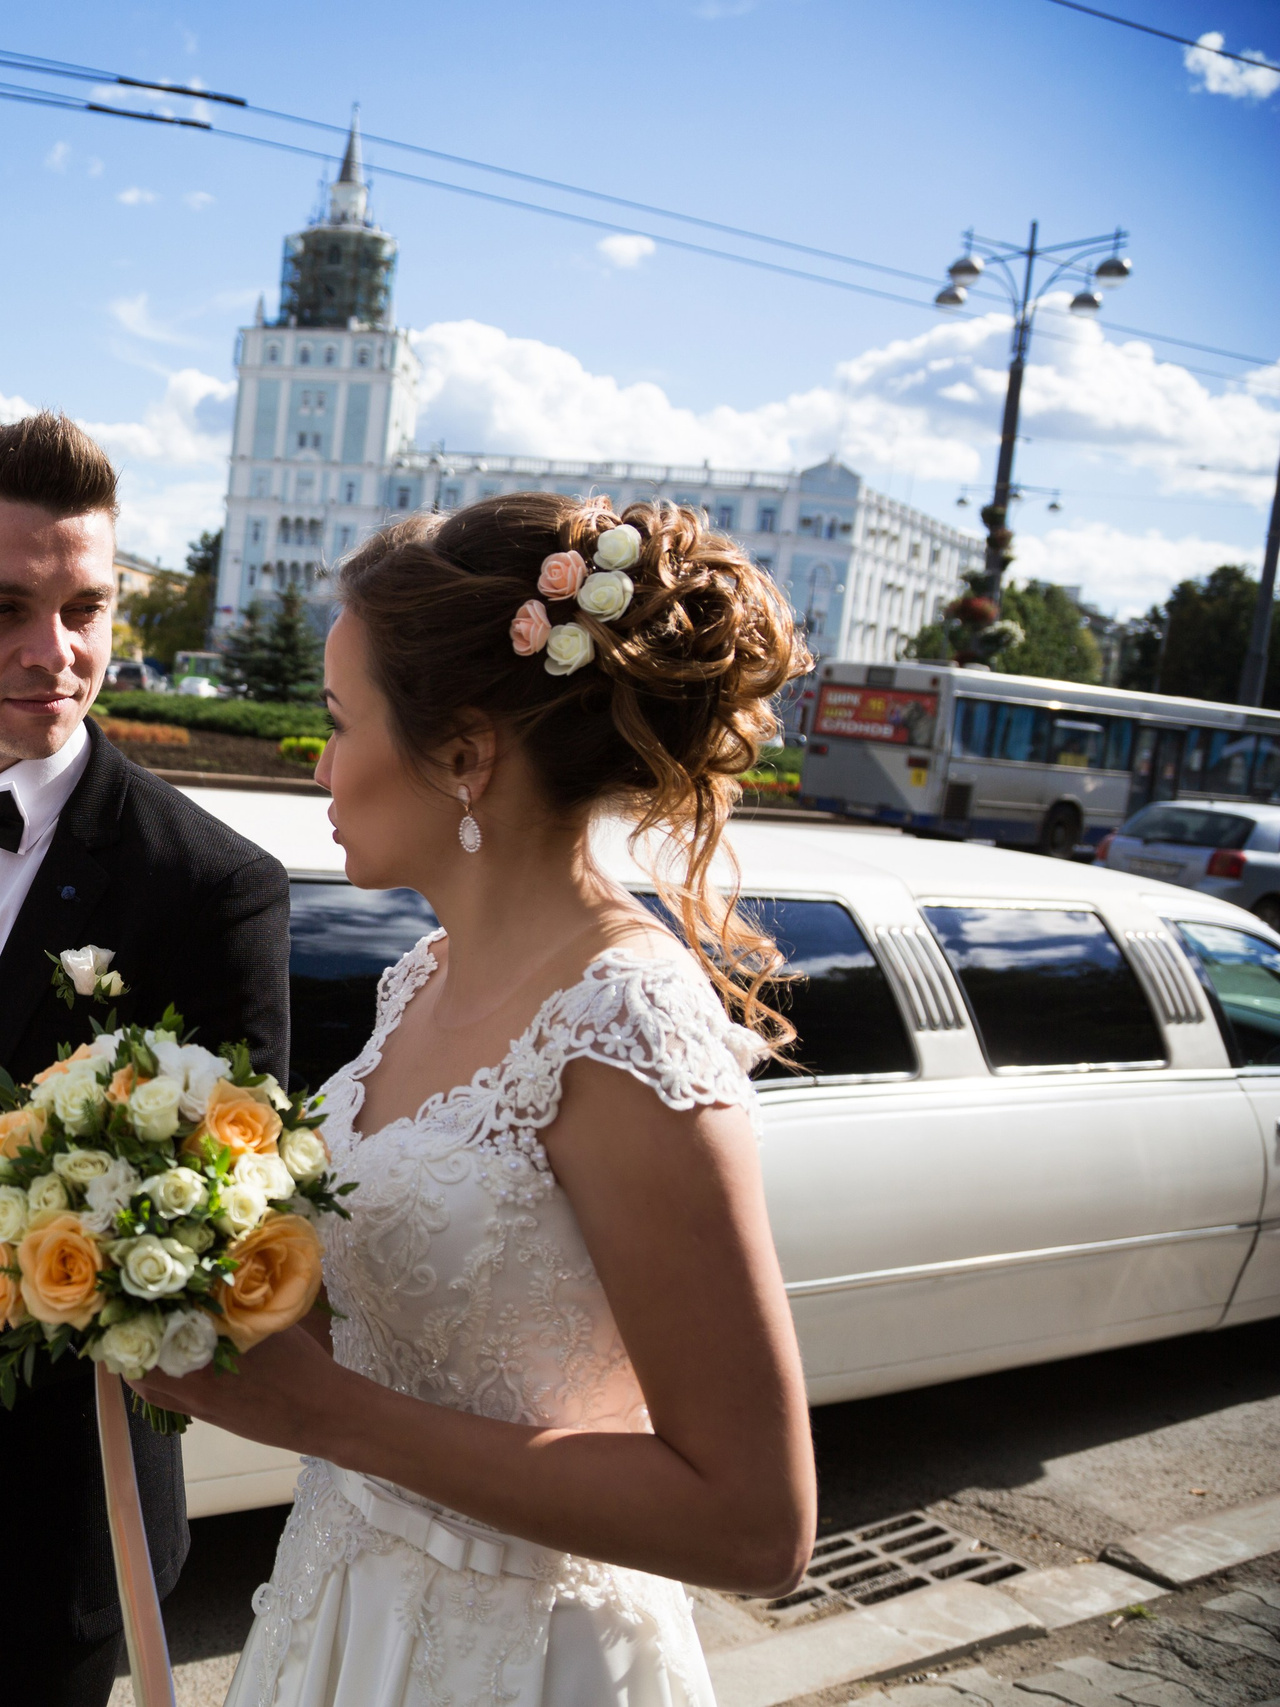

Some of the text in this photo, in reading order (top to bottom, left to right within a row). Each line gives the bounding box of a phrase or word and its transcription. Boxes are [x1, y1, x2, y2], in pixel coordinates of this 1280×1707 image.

[827, 691, 861, 706] ЦИРК
[825, 706, 855, 718] ШОУ
[822, 718, 894, 738] СЛОНОВ
